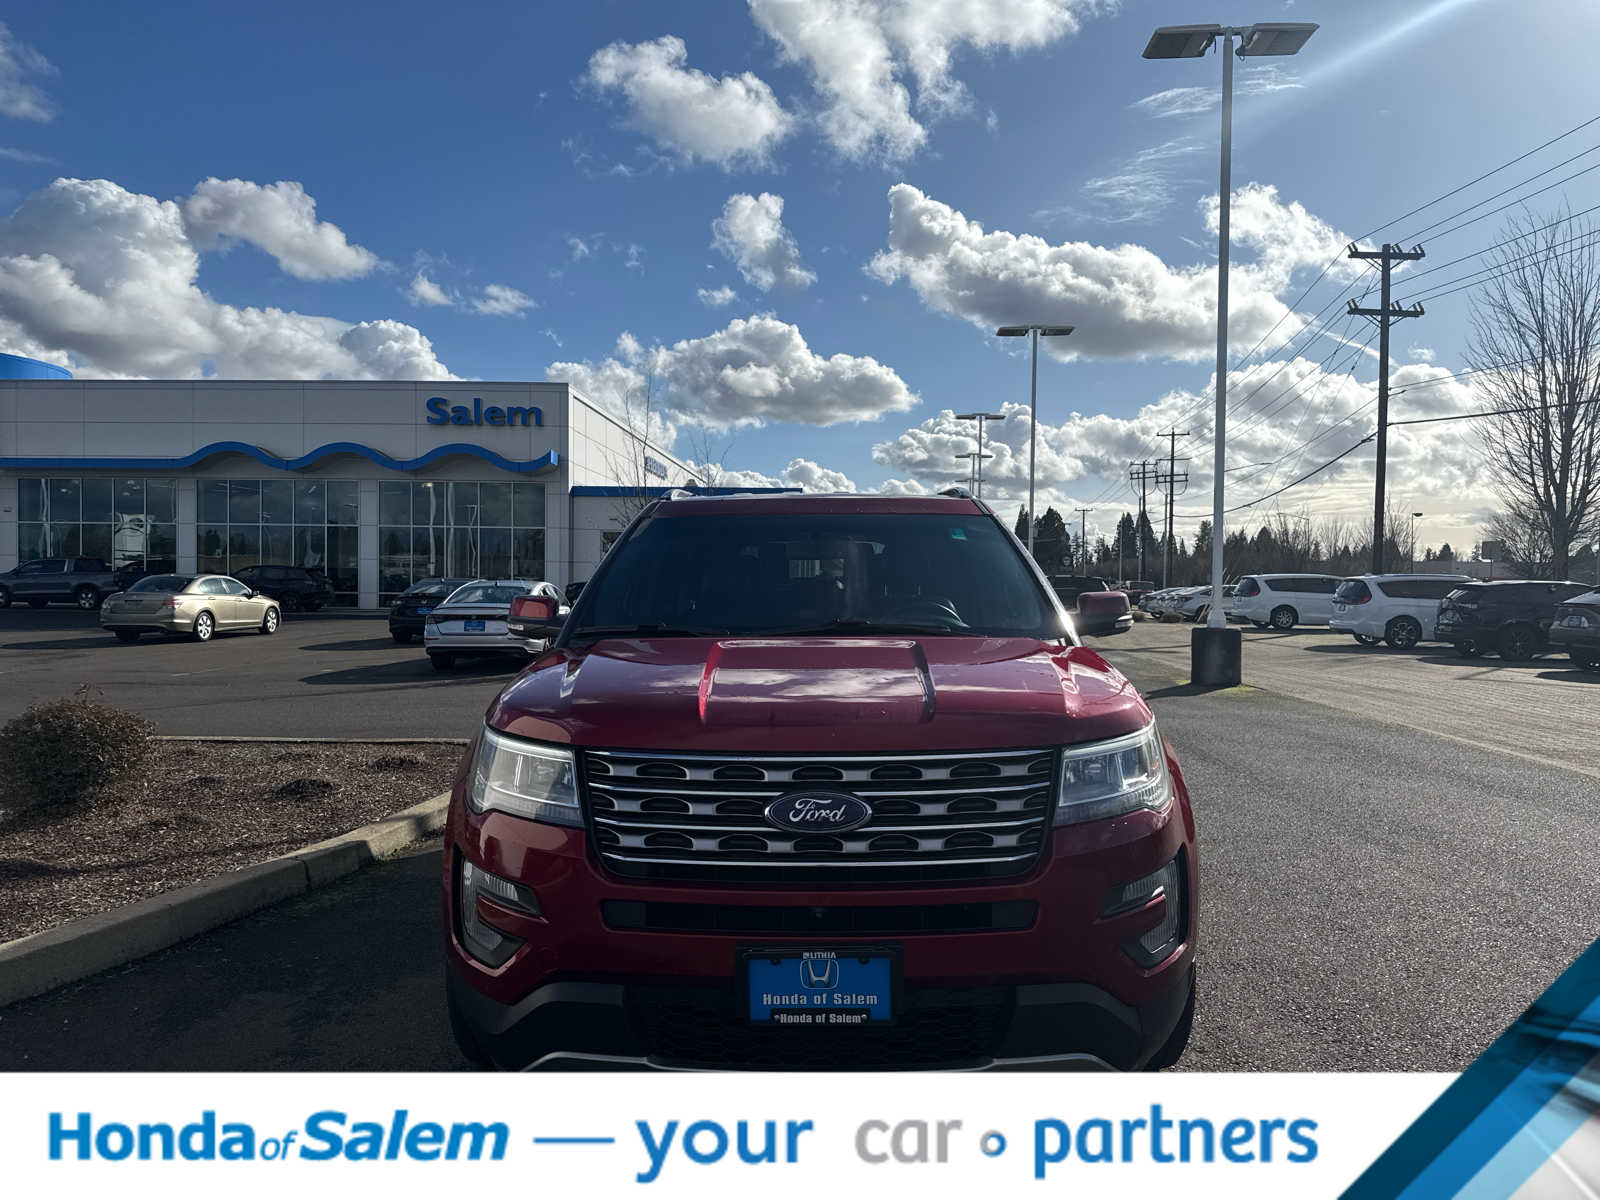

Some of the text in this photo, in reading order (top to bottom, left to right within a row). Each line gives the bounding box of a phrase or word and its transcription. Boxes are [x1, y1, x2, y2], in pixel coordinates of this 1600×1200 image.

[426, 397, 545, 427] Salem
[789, 798, 847, 822] Ford
[762, 993, 879, 1006] Honda of Salem
[780, 1013, 862, 1024] Honda of Salem
